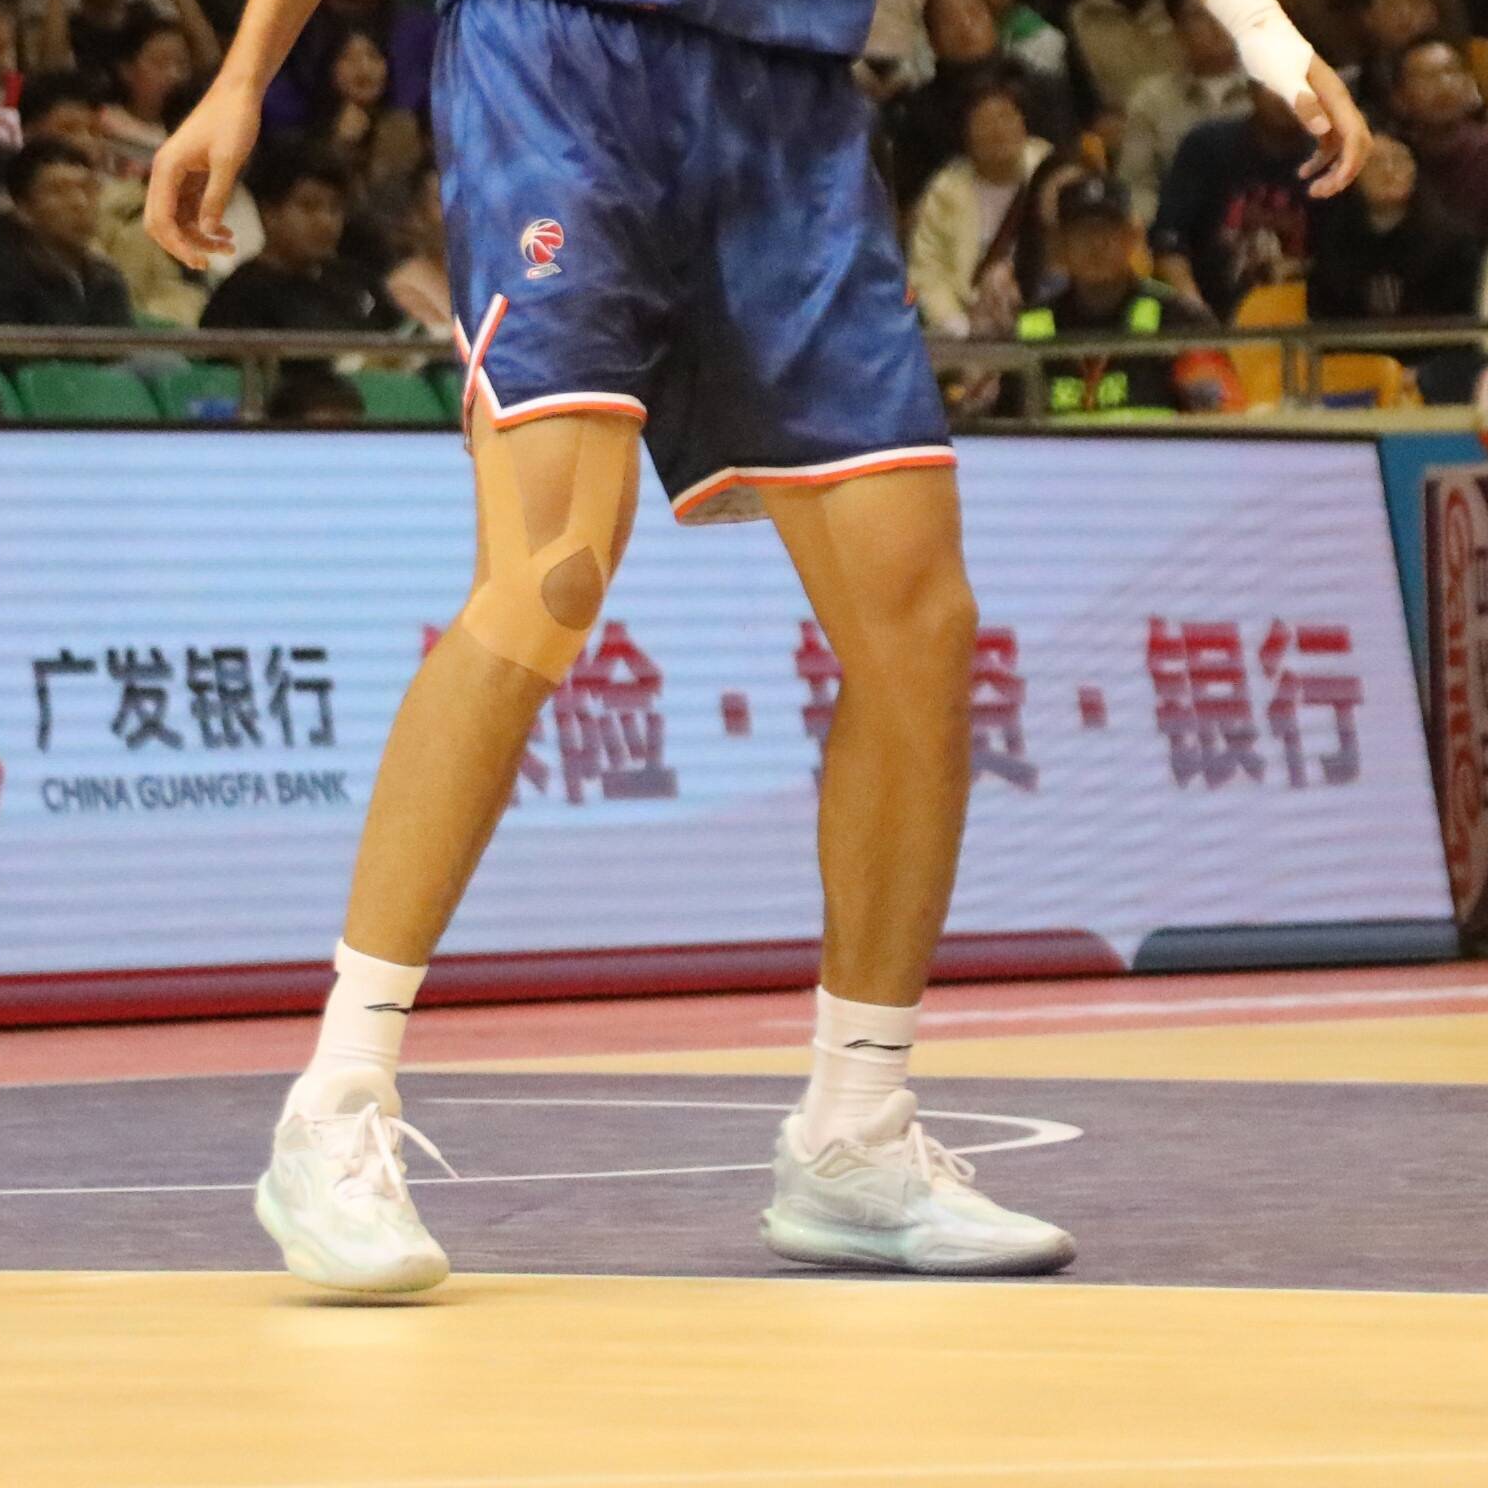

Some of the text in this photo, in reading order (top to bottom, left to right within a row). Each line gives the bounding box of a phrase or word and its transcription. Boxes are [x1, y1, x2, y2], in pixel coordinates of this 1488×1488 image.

[31, 645, 337, 753] 广发银行
[41, 768, 351, 813] CHINA GUANGFA BANK
